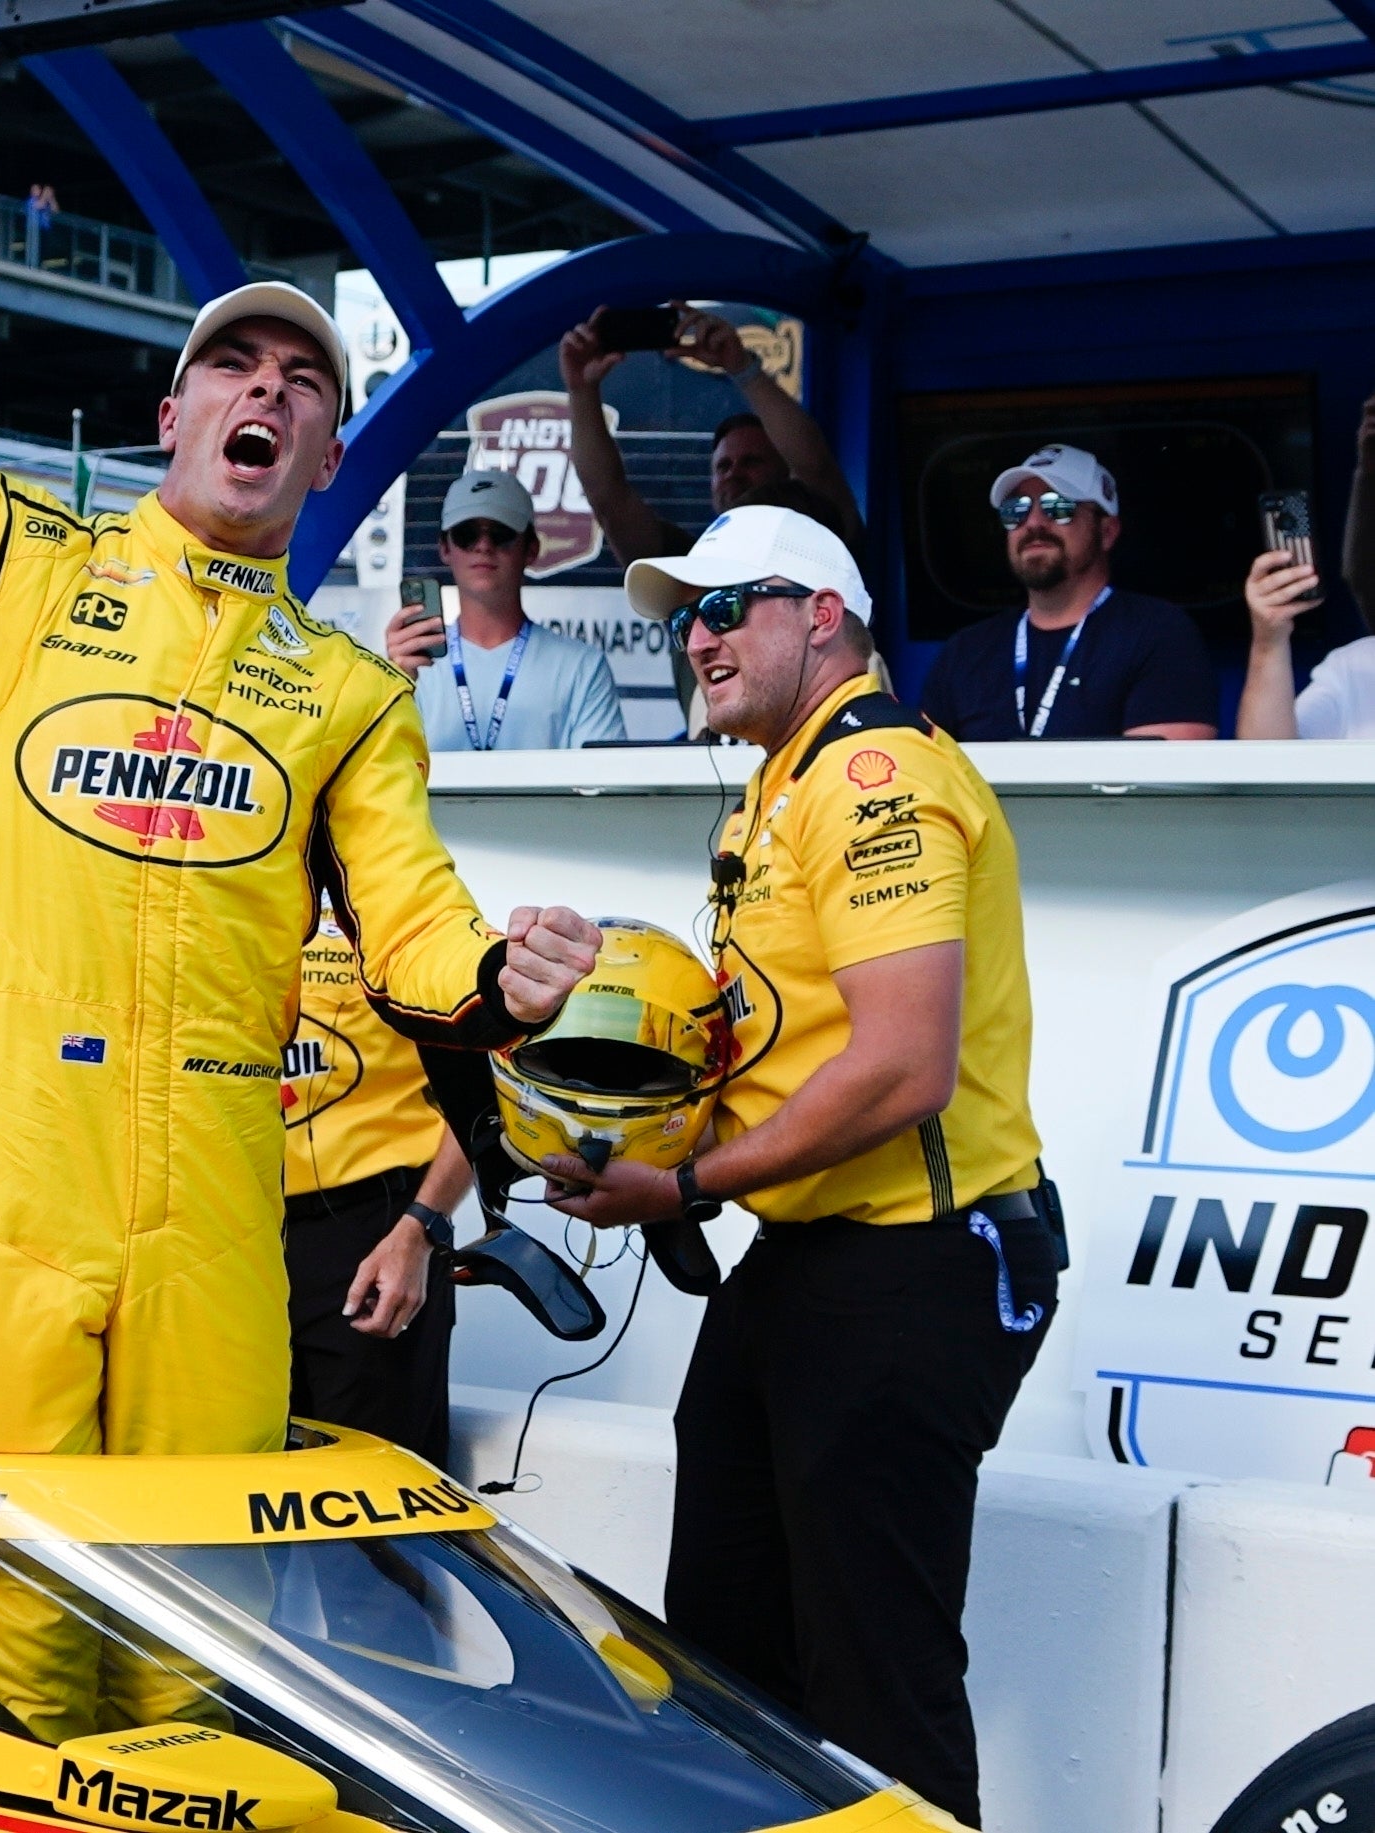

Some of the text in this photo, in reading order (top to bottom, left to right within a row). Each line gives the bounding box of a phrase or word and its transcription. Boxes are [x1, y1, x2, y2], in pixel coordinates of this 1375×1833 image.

[73, 594, 125, 627] PPG
[41, 634, 137, 664] Snap-on
[233, 659, 313, 694] verizon
[227, 681, 323, 719] HITACHI
[50, 748, 255, 814] PENNZOIL
[852, 839, 915, 863] PENSKE
[849, 879, 930, 910] SIEMENS
[108, 1730, 222, 1755] SIEMENS
[58, 1758, 261, 1832] Mazak
